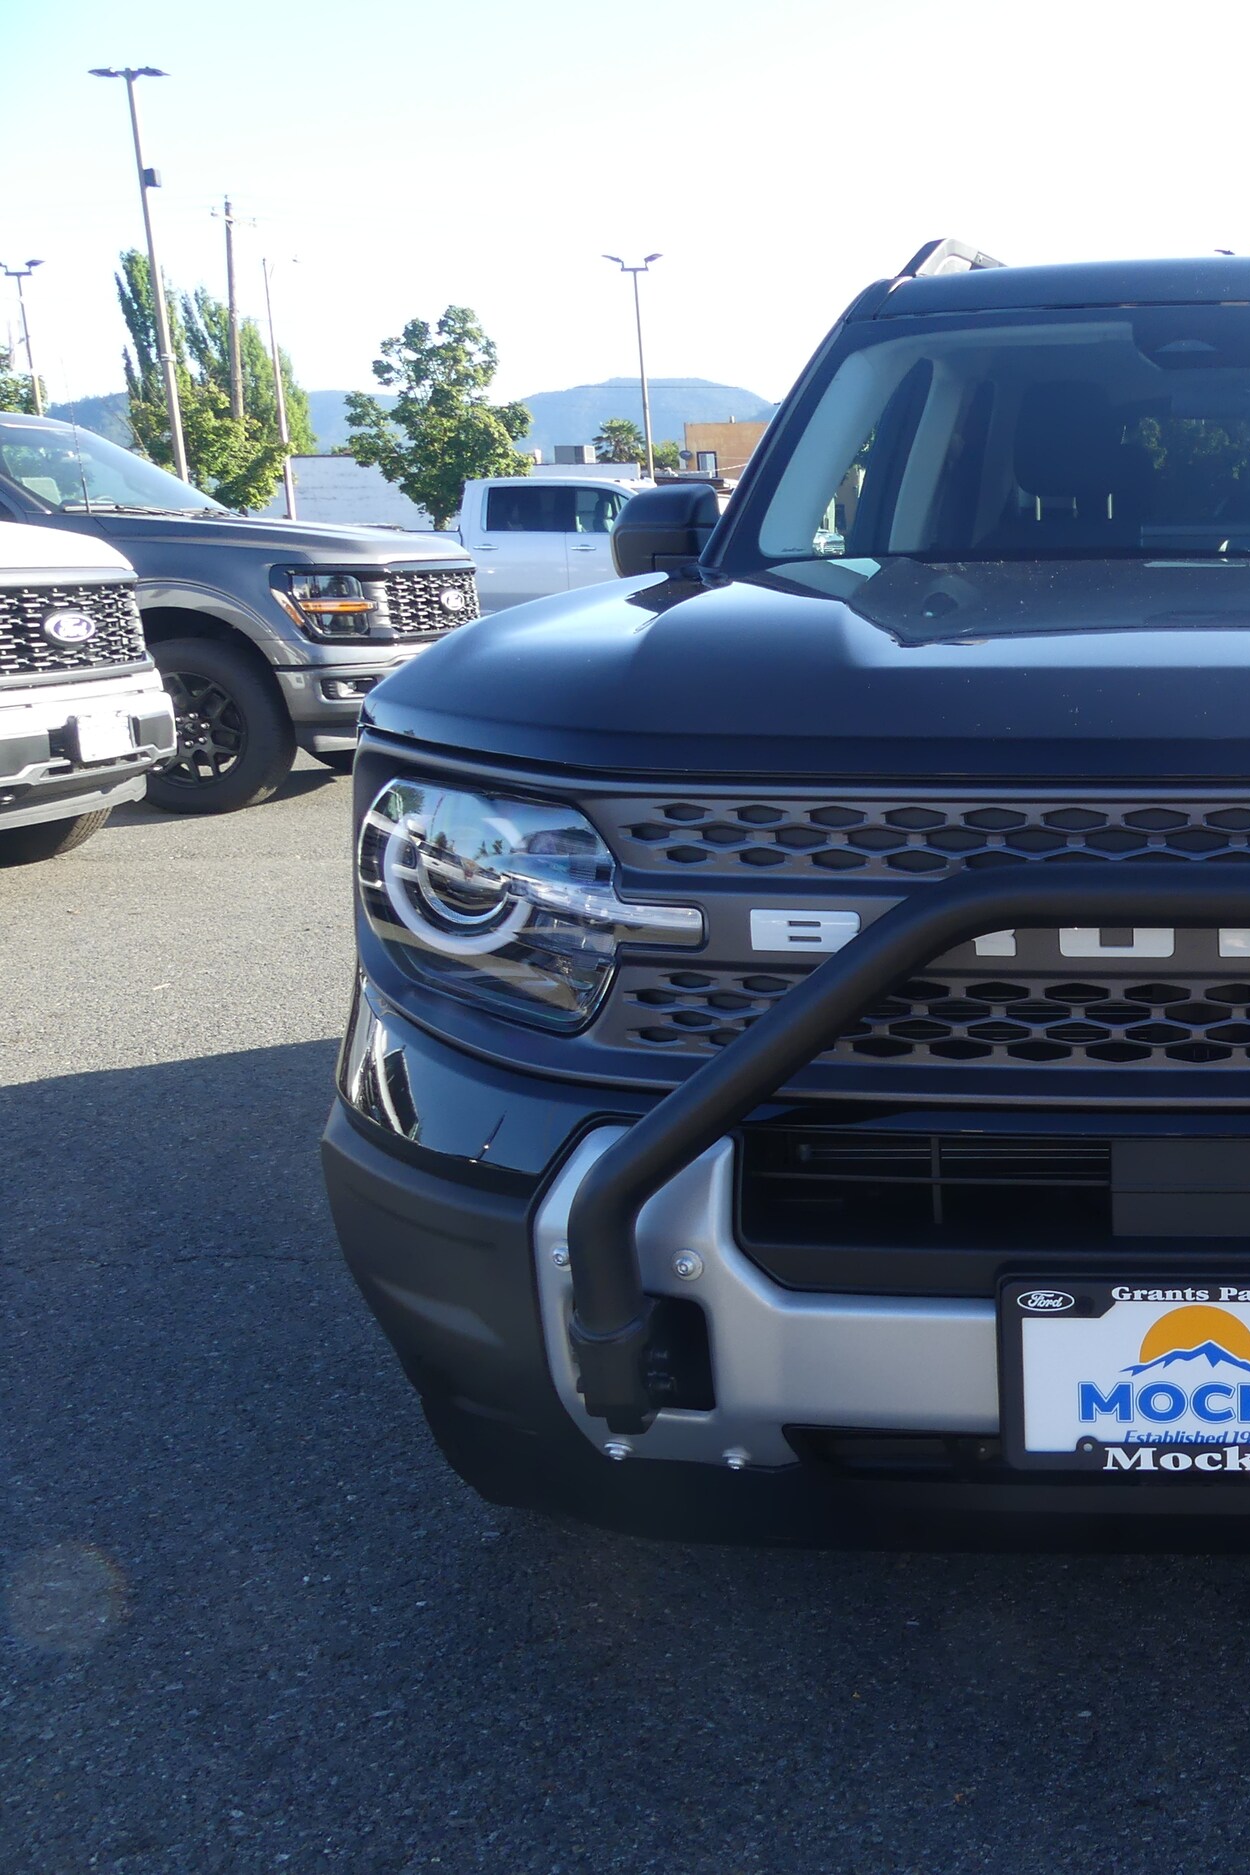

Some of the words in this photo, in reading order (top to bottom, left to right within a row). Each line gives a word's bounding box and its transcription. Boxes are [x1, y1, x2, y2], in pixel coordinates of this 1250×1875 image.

[1028, 1293, 1063, 1308] Ford
[1111, 1286, 1209, 1302] Grants
[1124, 1430, 1229, 1444] Established
